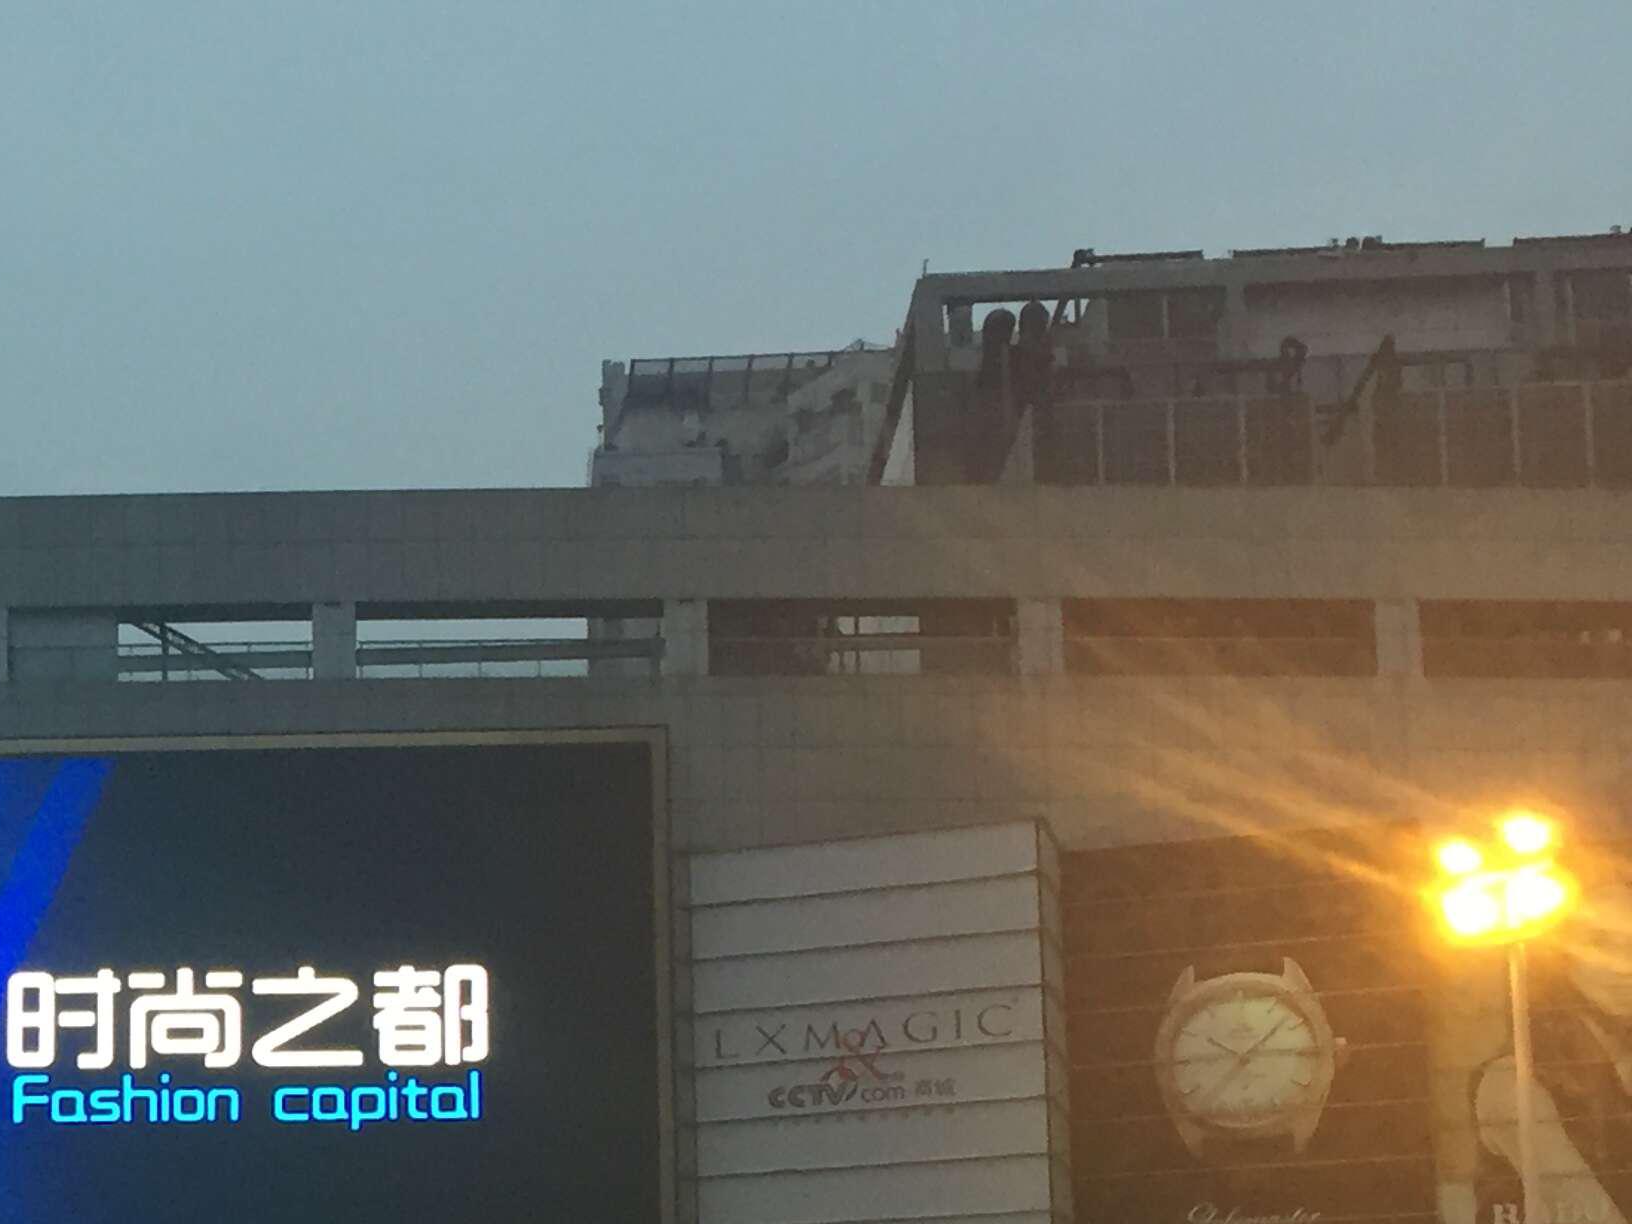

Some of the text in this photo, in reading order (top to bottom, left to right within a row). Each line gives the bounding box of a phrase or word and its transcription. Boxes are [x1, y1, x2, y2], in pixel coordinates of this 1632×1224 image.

[7, 964, 489, 1070] 时尚之都
[12, 1070, 482, 1130] Fashion capital
